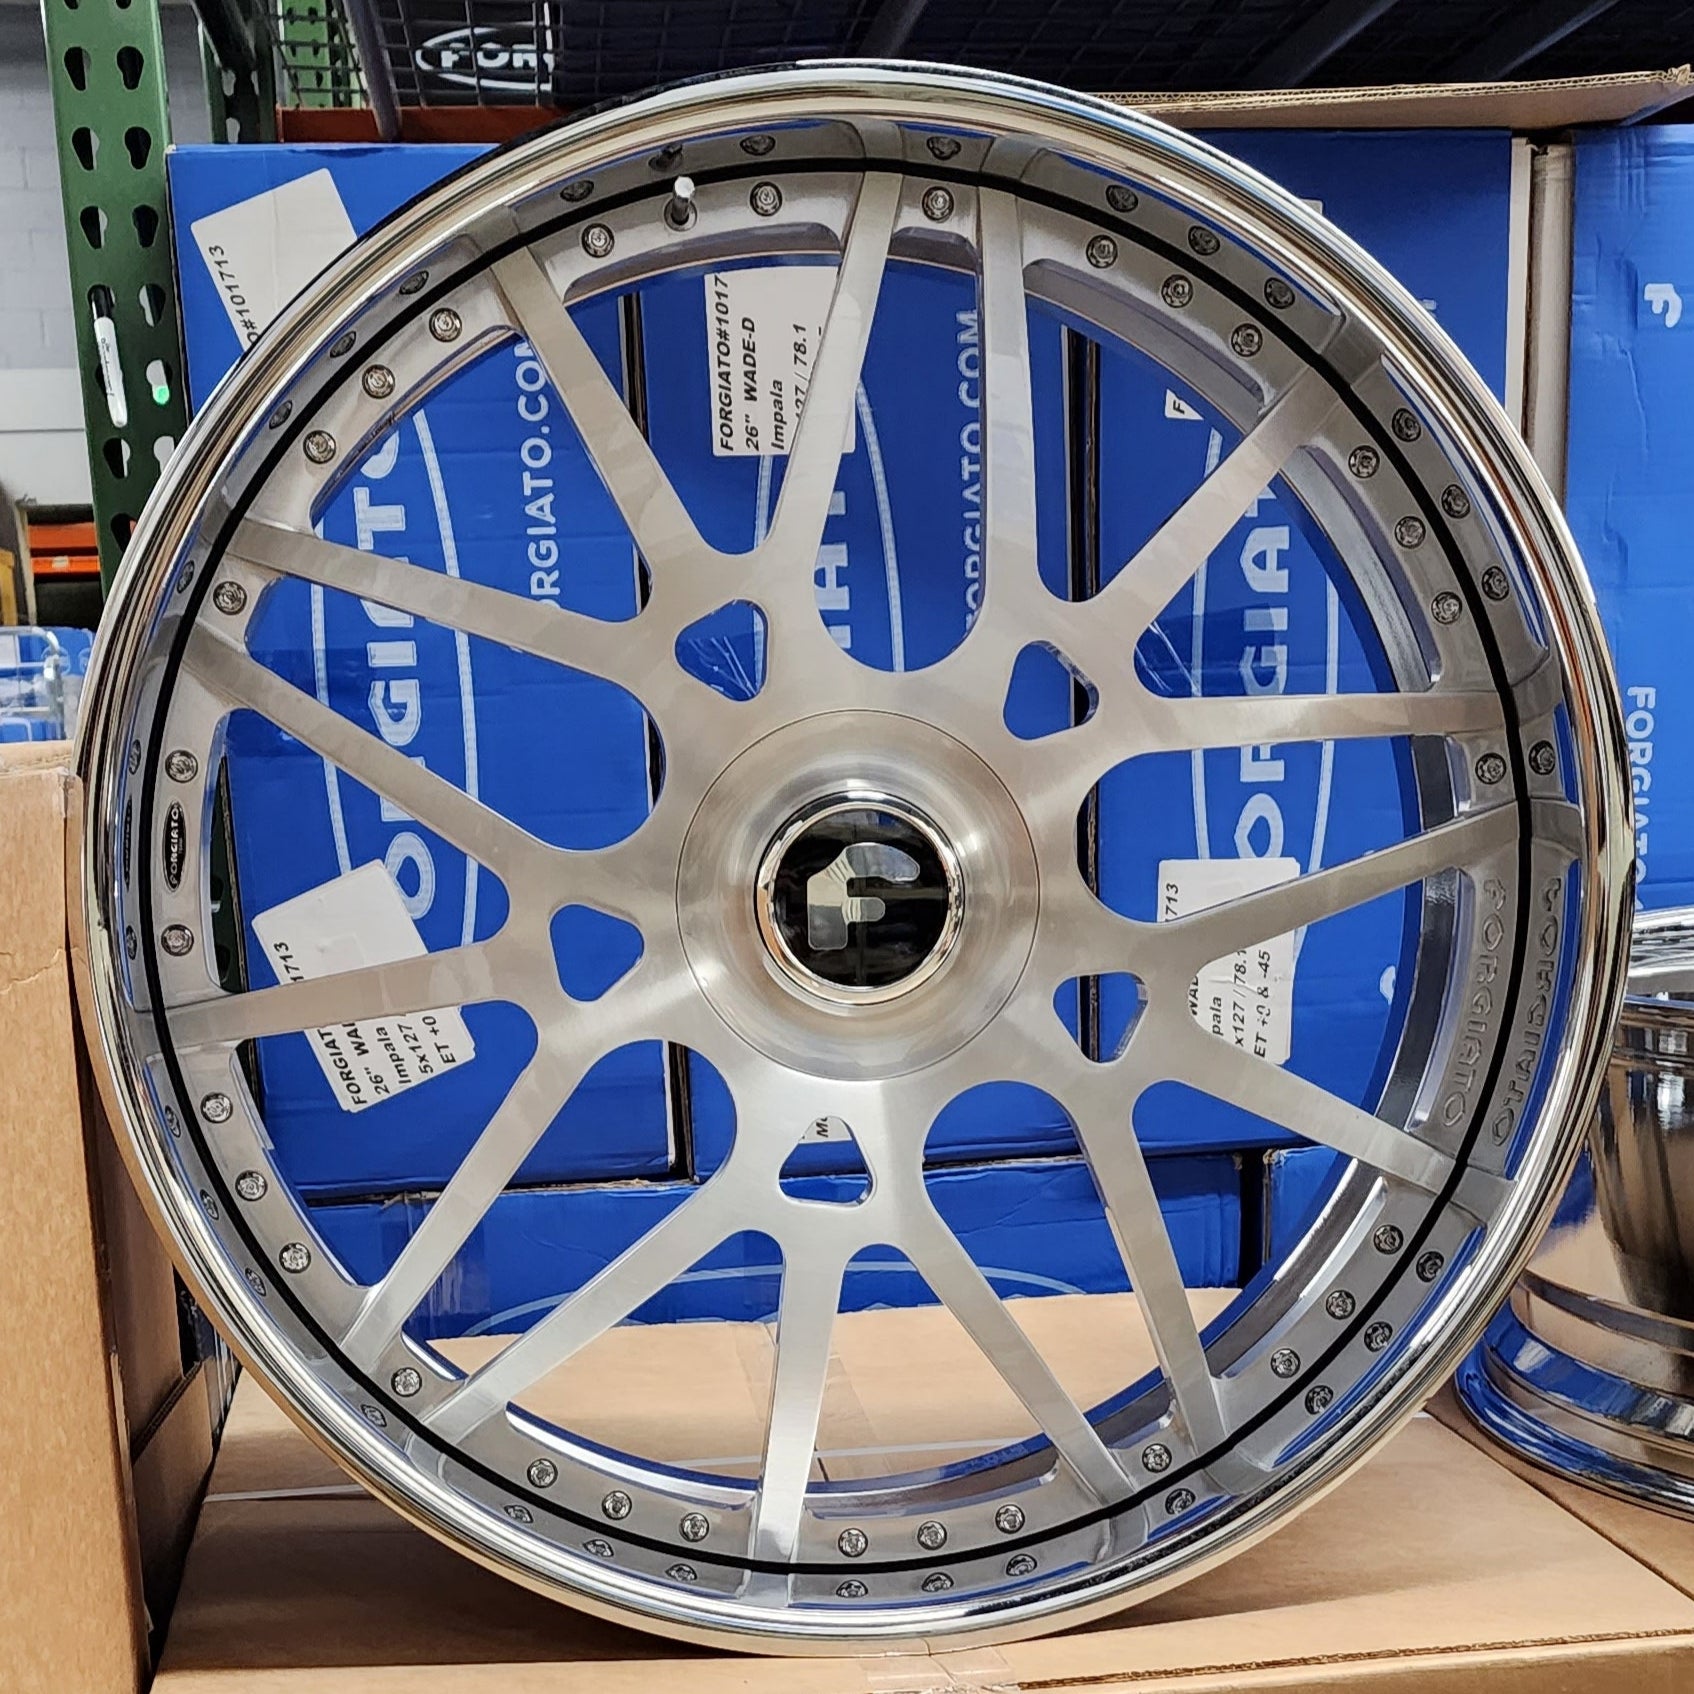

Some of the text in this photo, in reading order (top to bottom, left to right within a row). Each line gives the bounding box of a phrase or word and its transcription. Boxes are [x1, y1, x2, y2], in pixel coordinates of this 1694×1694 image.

[741, 316, 758, 402] WADE-D
[792, 323, 808, 367] 78.1
[769, 379, 787, 450] Impala
[515, 340, 560, 608] RGIATO.CO
[375, 1026, 412, 1084] Impala
[397, 1023, 434, 1074] 5x127
[433, 1041, 456, 1064] ET
[1253, 1033, 1268, 1058] ET
